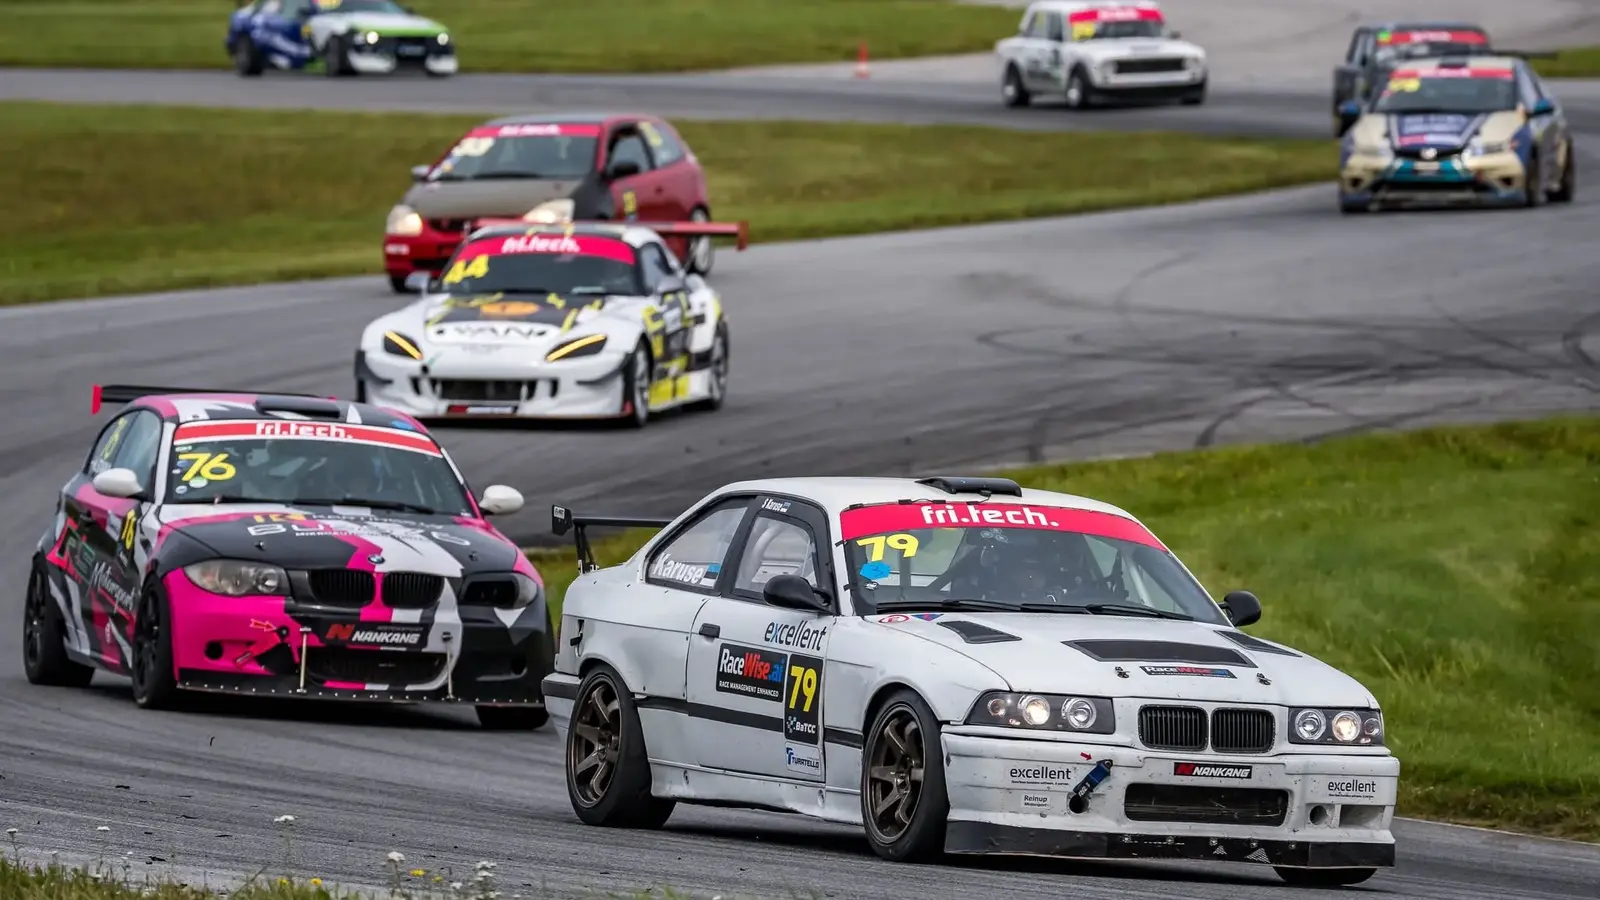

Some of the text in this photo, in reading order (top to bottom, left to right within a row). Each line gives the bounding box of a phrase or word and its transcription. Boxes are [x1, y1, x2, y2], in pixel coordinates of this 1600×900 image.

[443, 254, 489, 284] 44
[255, 421, 353, 440] fri.tech.
[178, 452, 236, 481] 76
[921, 505, 1059, 527] fri.tech.
[856, 533, 919, 562] 79
[652, 552, 705, 584] Karuse
[351, 631, 421, 645] NANKANG
[764, 619, 827, 651] excellent
[719, 648, 786, 683] RaceWise.ai
[719, 680, 779, 698] RACE MANAGEMENT ENHANCED
[788, 665, 818, 713] 79
[1010, 766, 1072, 780] excellent
[1192, 766, 1251, 779] NANKANG
[1327, 779, 1376, 793] excellent
[1023, 794, 1048, 803] Reinup
